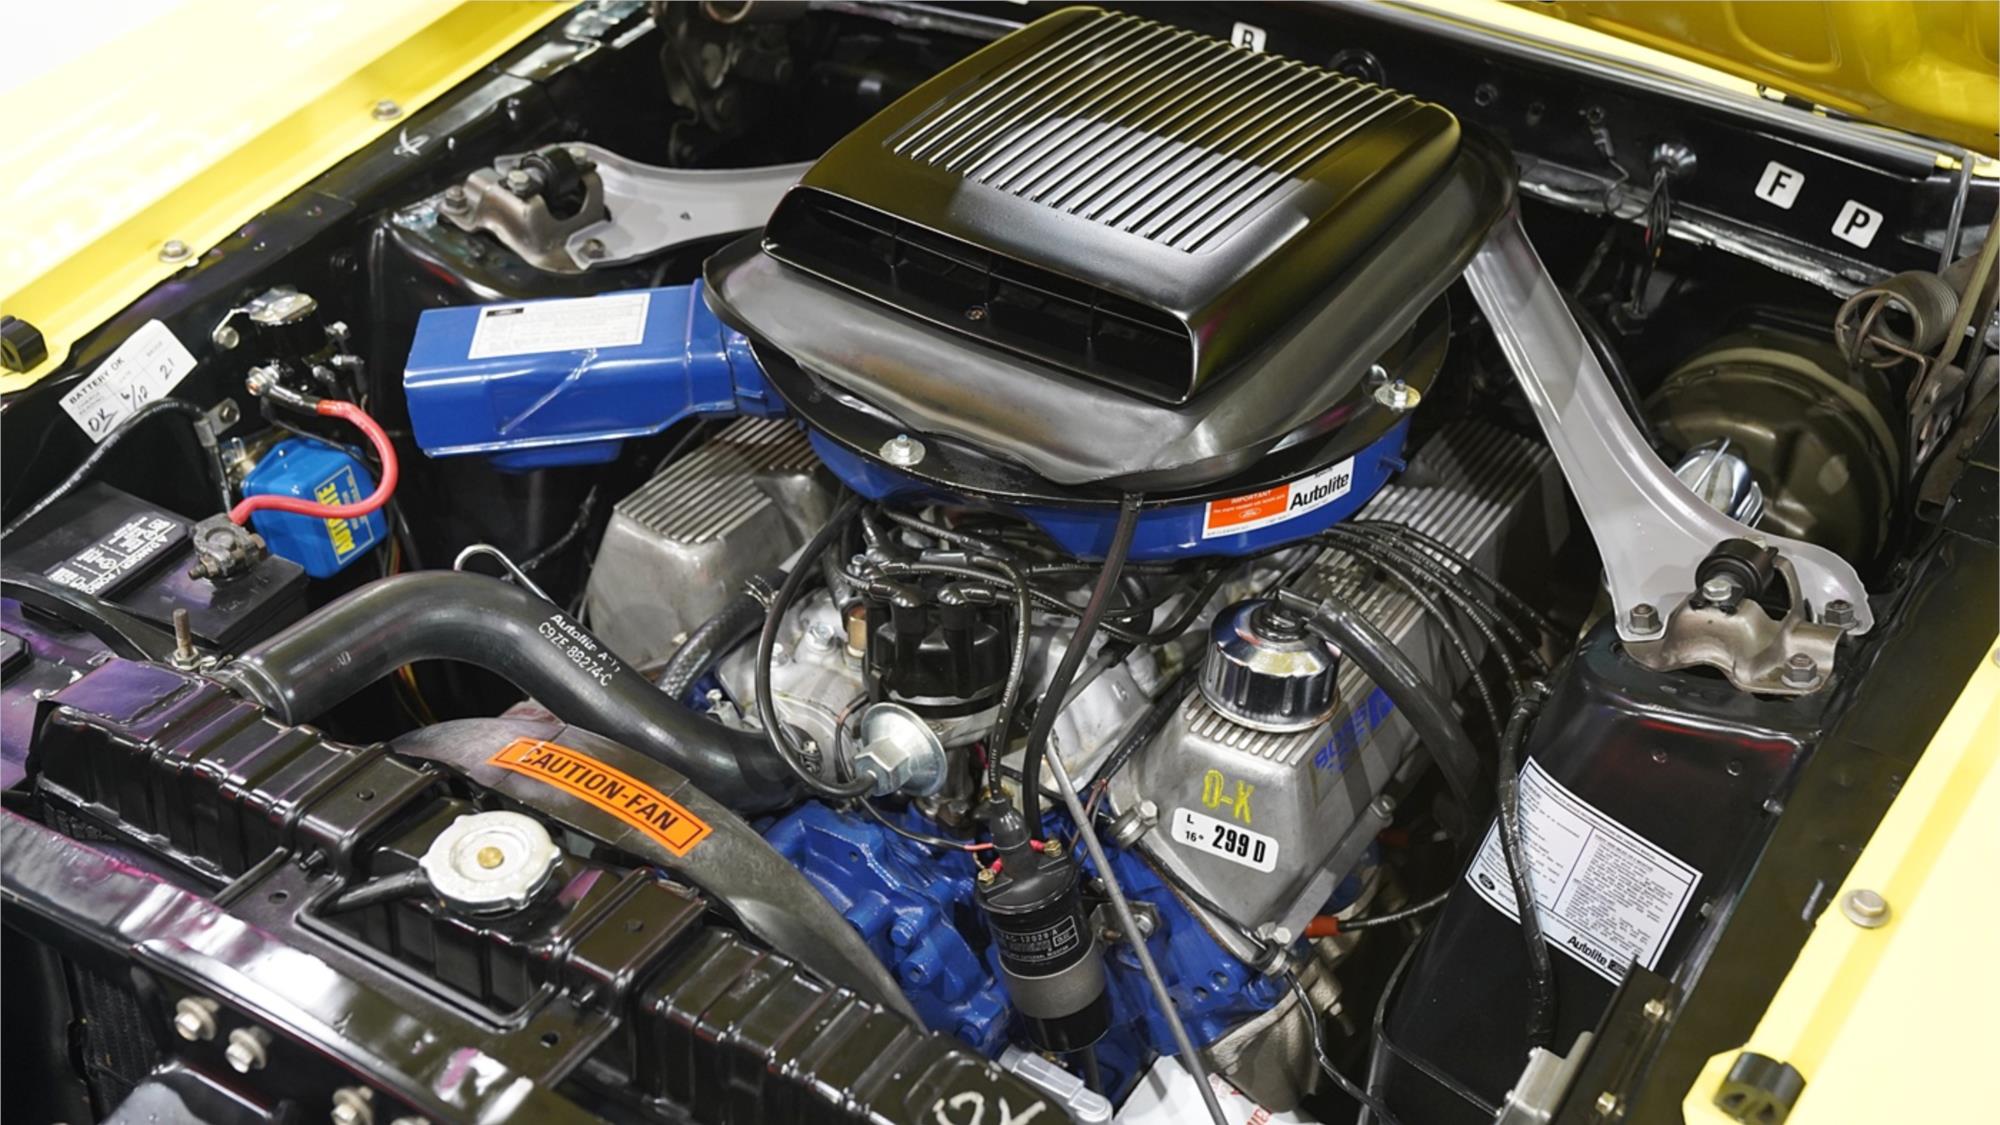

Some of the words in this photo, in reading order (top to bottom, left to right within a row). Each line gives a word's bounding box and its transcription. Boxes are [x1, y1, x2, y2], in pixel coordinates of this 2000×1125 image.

[1767, 170, 1792, 197] F
[1843, 208, 1870, 235] P
[69, 371, 110, 404] BATTERY
[87, 407, 118, 432] OK
[1290, 473, 1349, 511] Autolite
[521, 747, 679, 832] CAUTION-FAN
[1187, 813, 1194, 825] L
[1212, 824, 1250, 858] 299
[1253, 839, 1266, 864] D
[1566, 934, 1609, 965] Autolite
